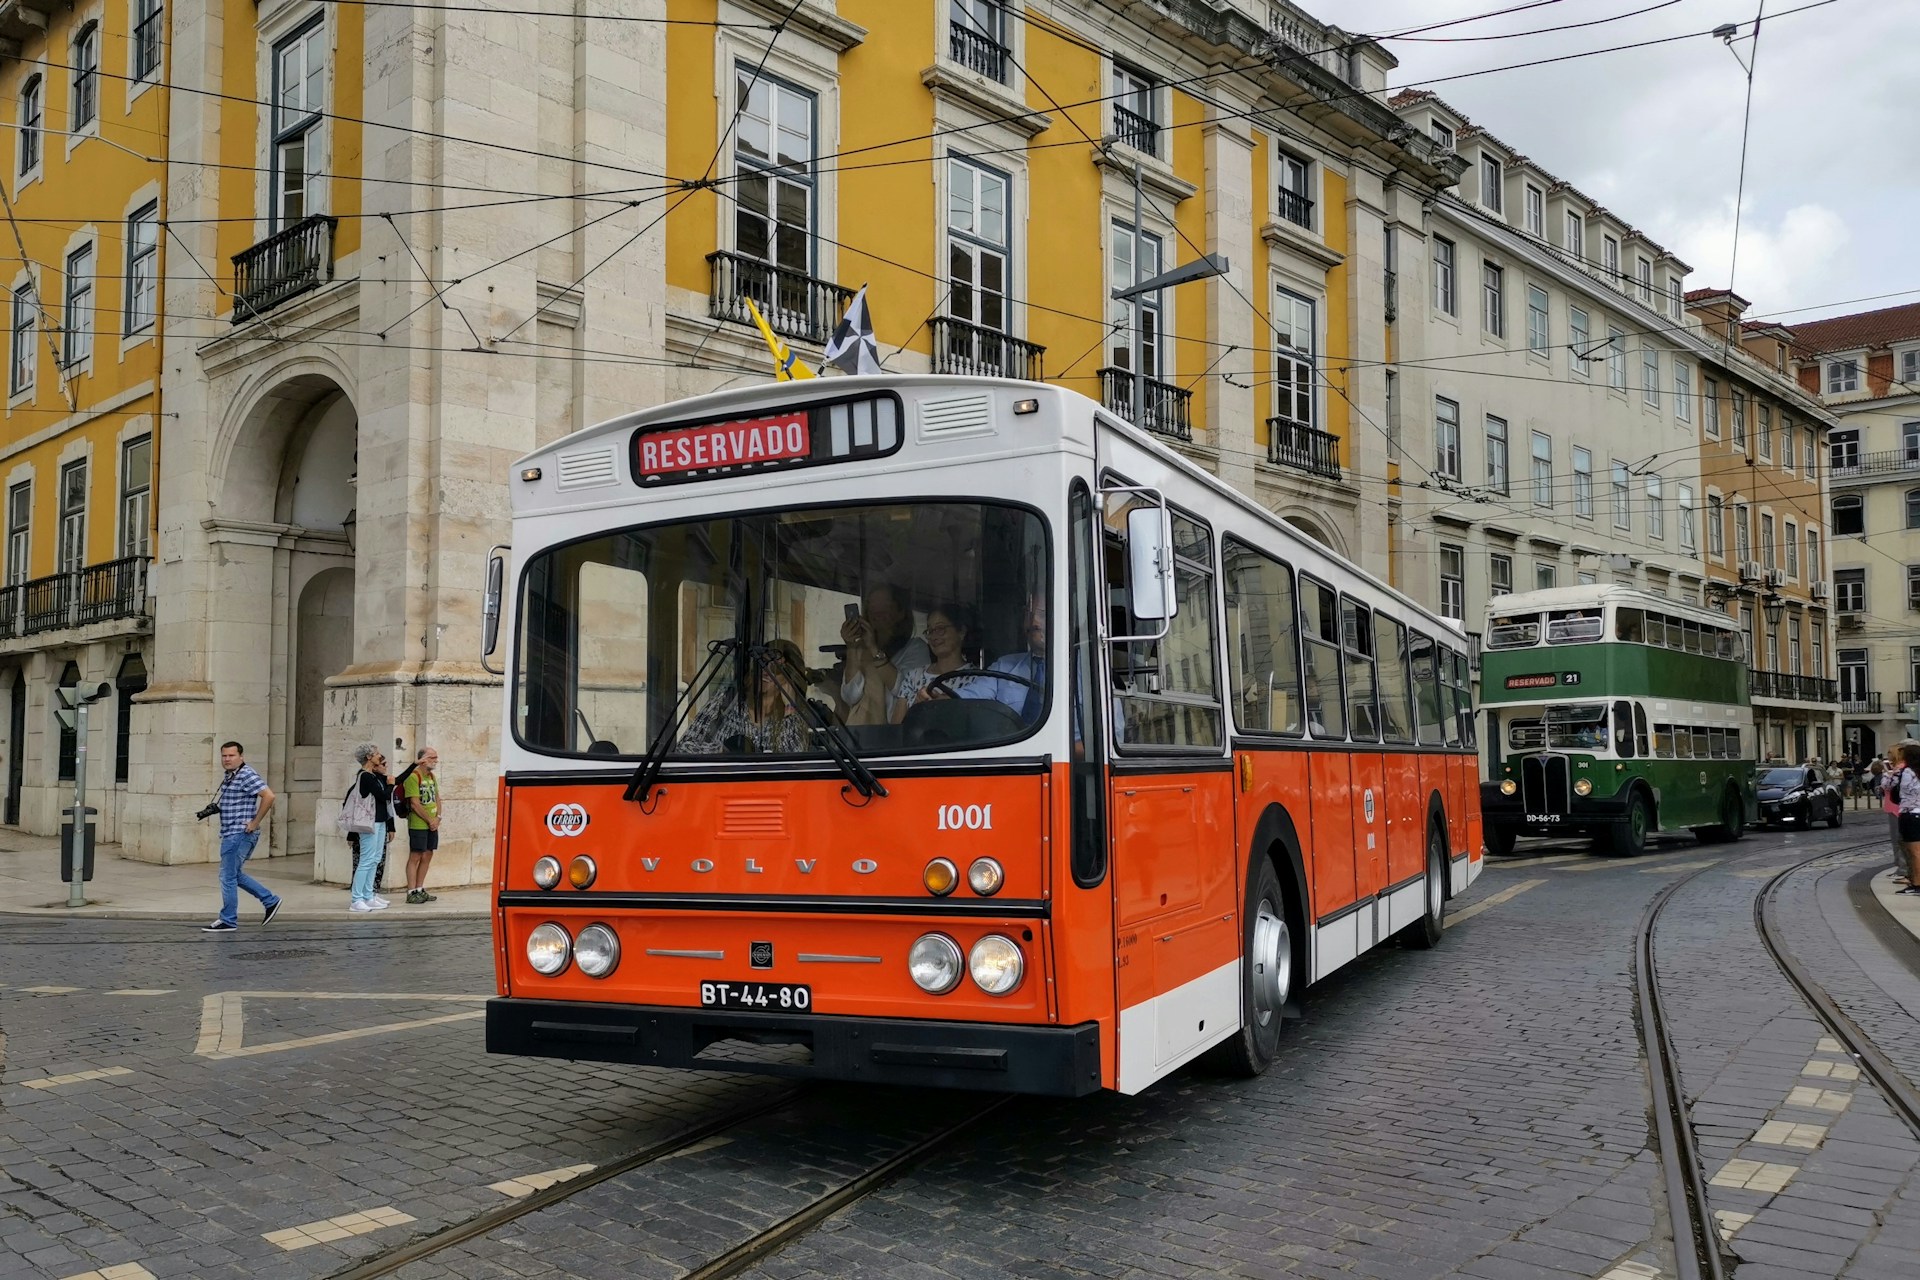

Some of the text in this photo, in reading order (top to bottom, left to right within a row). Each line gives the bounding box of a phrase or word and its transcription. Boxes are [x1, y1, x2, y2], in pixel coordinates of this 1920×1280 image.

[642, 422, 803, 470] RESERVADO
[1508, 673, 1578, 687] RESERVADO 21
[552, 814, 582, 825] CARRIS
[937, 803, 993, 830] 1001
[1526, 814, 1561, 822] DD-56-73
[640, 857, 878, 874] VOLVO
[701, 983, 809, 1009] BT-44-80
